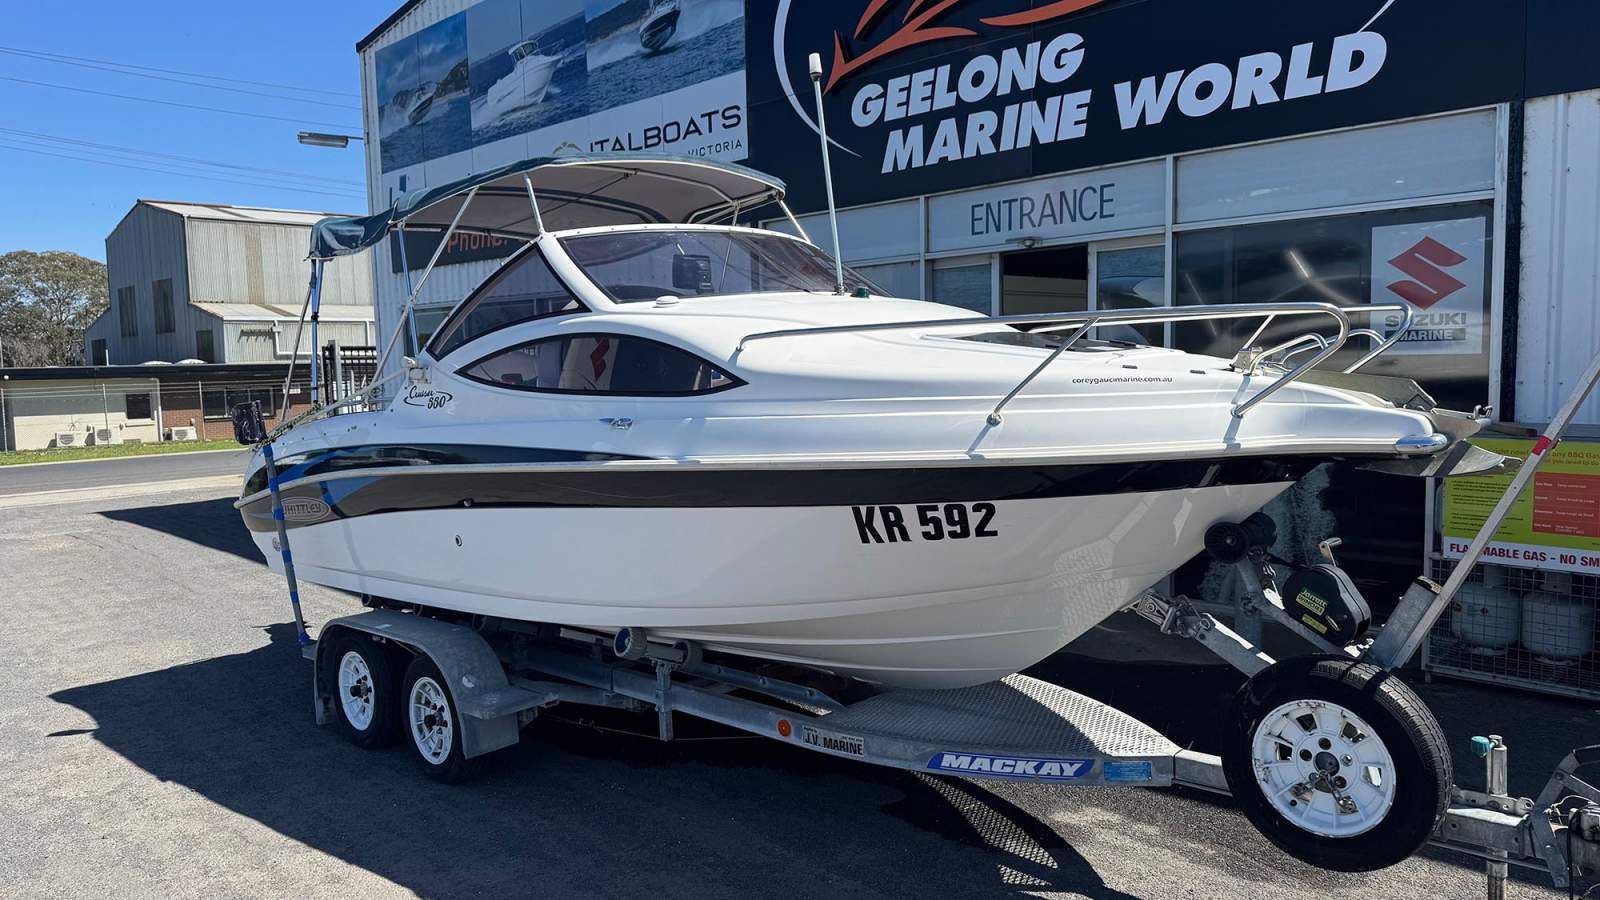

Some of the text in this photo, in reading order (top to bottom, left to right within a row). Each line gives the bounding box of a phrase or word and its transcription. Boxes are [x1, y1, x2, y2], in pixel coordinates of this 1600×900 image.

[850, 32, 1086, 129] GEELONG
[880, 30, 1388, 174] MARINE WORLD
[971, 183, 1116, 236] ENTRANCE
[851, 502, 999, 544] KR 592
[1449, 543, 1519, 560] FLAMABLE
[1523, 551, 1547, 562] GAS
[1559, 554, 1577, 565] NO
[804, 732, 863, 756] J.V. MARINE
[940, 753, 1084, 777] MACKAY
